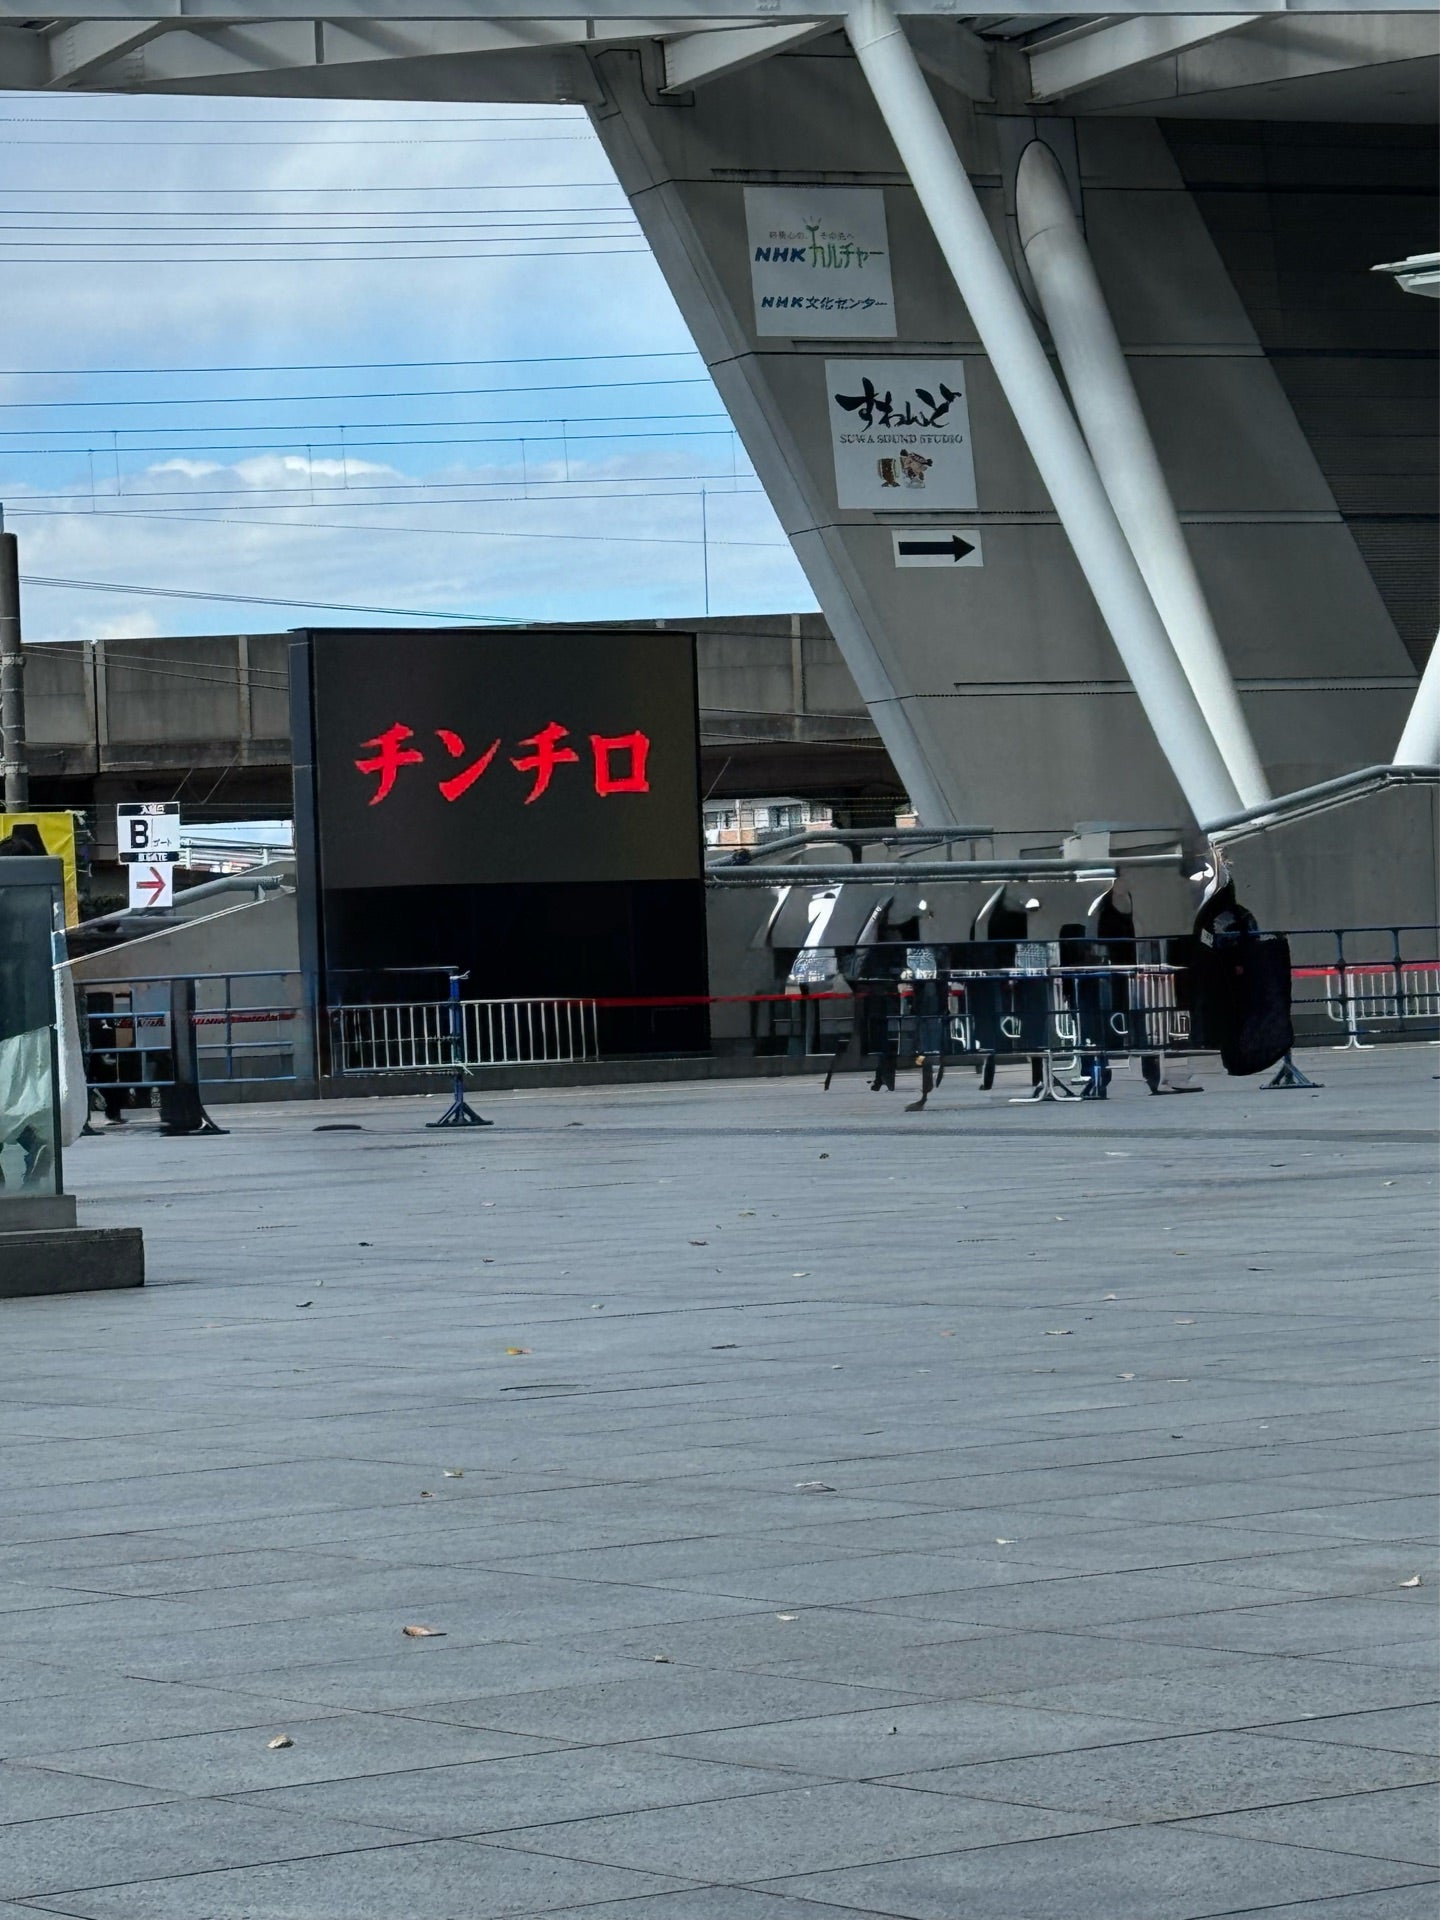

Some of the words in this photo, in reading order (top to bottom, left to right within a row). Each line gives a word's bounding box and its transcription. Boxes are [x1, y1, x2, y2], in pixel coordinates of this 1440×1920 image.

[839, 434, 875, 444] SUWA
[877, 434, 917, 444] SOUND
[920, 434, 963, 444] STUDIO
[354, 721, 651, 806] チンチロ
[130, 819, 149, 849] B
